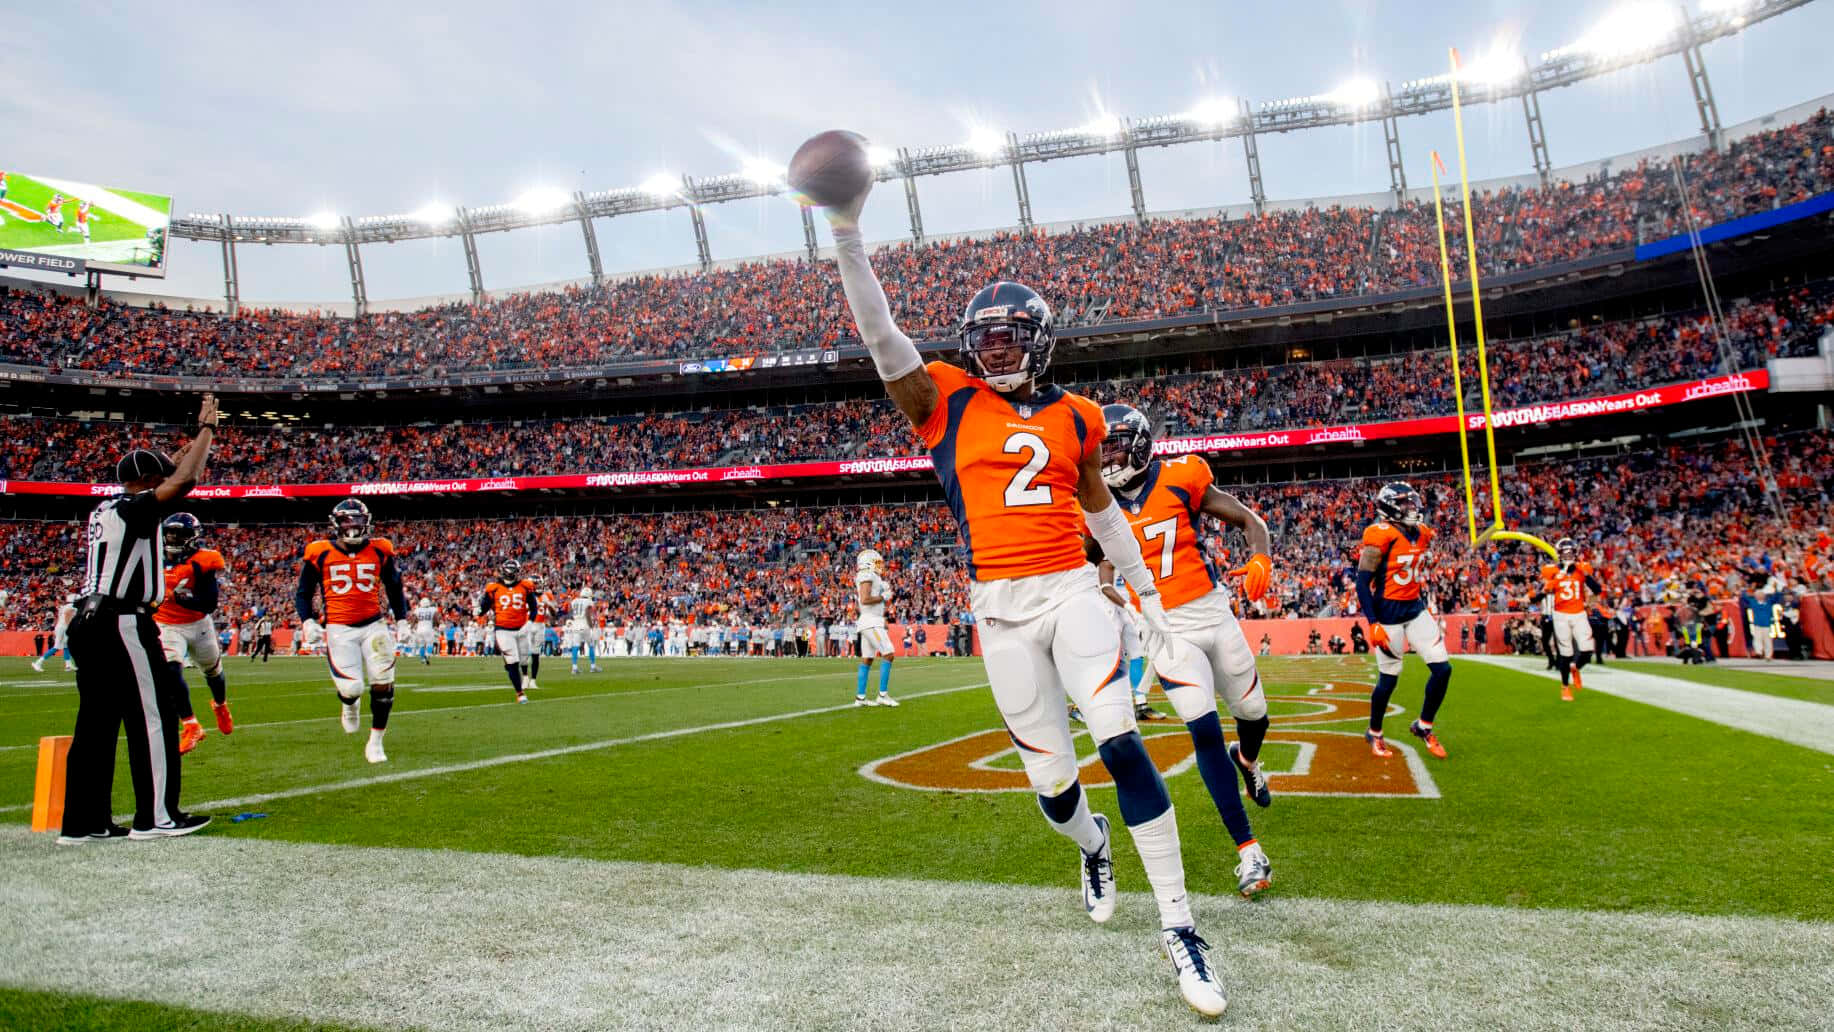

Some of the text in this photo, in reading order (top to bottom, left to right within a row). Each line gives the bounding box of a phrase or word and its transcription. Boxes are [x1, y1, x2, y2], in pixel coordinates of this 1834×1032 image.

[38, 257, 75, 269] FIELD
[1686, 375, 1750, 398] uchealth
[1635, 393, 1661, 406] Out
[1268, 434, 1289, 445] Out
[1310, 426, 1362, 442] uchealth
[723, 467, 761, 480] uchealth
[1002, 431, 1053, 507] 2
[692, 471, 708, 481] Out
[452, 482, 466, 491] Out
[481, 479, 516, 490] uchealth
[215, 488, 230, 497] Out
[245, 486, 282, 497] uchealth
[1138, 515, 1178, 581] 7
[329, 563, 376, 595] 55
[1559, 580, 1580, 601] 31
[499, 593, 524, 611] 95
